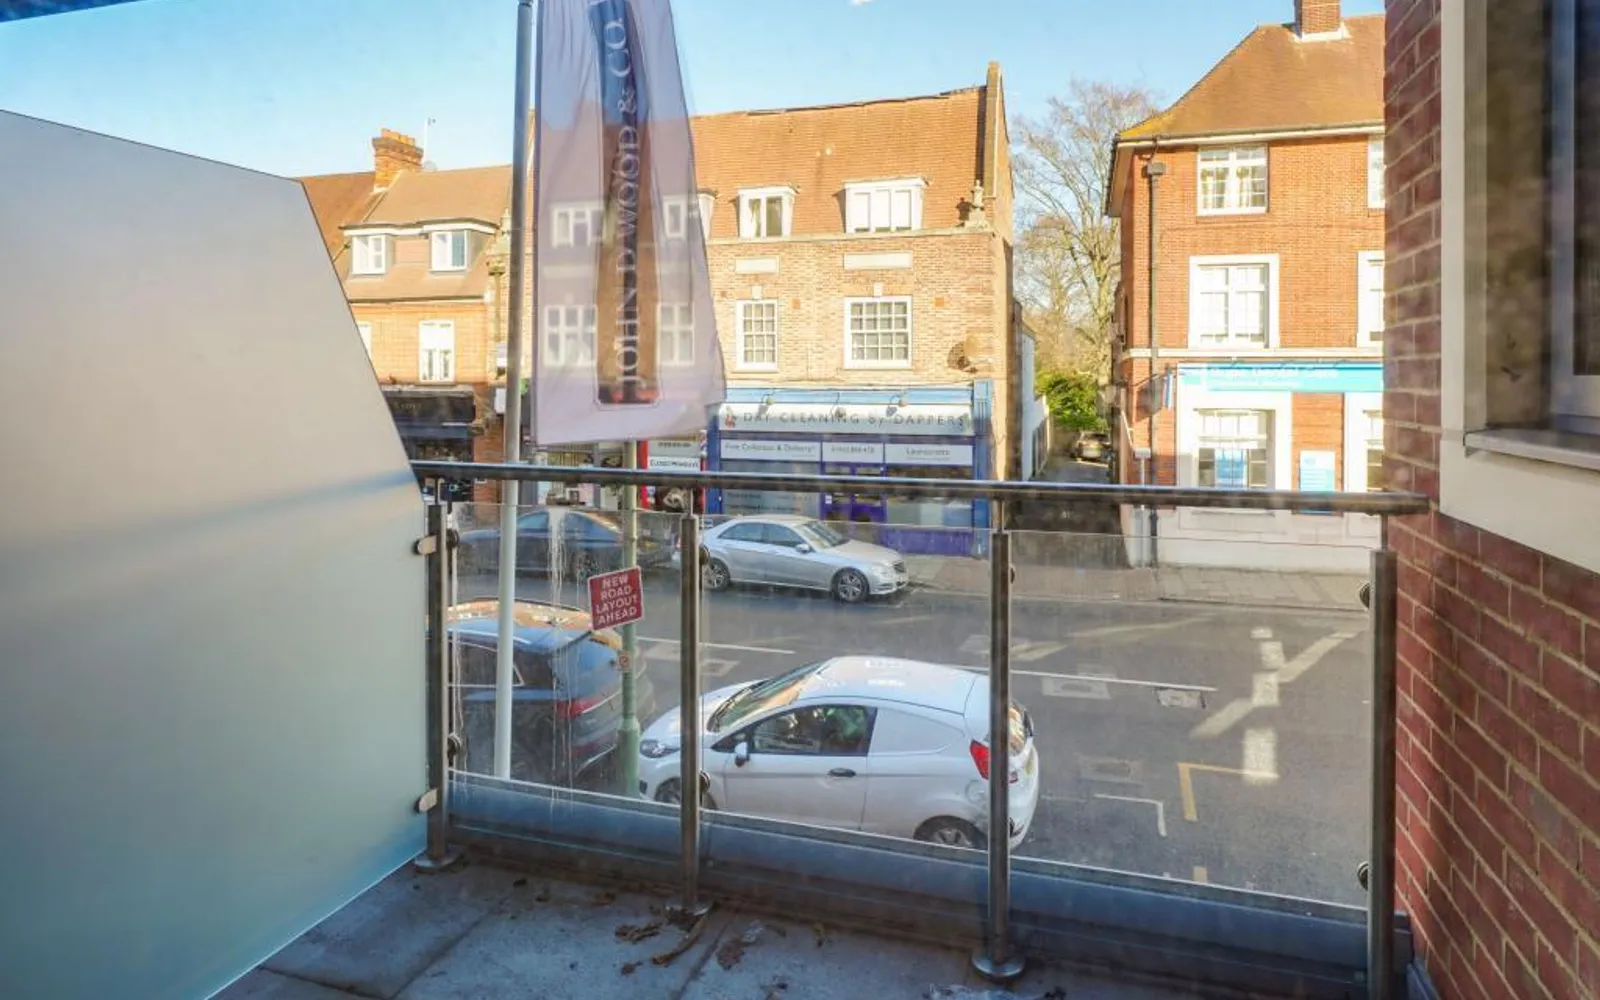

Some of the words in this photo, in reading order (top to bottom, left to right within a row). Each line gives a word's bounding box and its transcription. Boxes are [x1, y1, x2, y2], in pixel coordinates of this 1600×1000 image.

[616, 86, 638, 115] &
[613, 125, 641, 239] WOOD
[614, 247, 637, 273] D
[615, 287, 647, 390] JOHN
[779, 412, 859, 424] CLEANING
[602, 573, 629, 589] NEW
[600, 586, 631, 601] ROAD
[596, 595, 637, 615] LAYOUT
[597, 606, 637, 625] AHEAD
